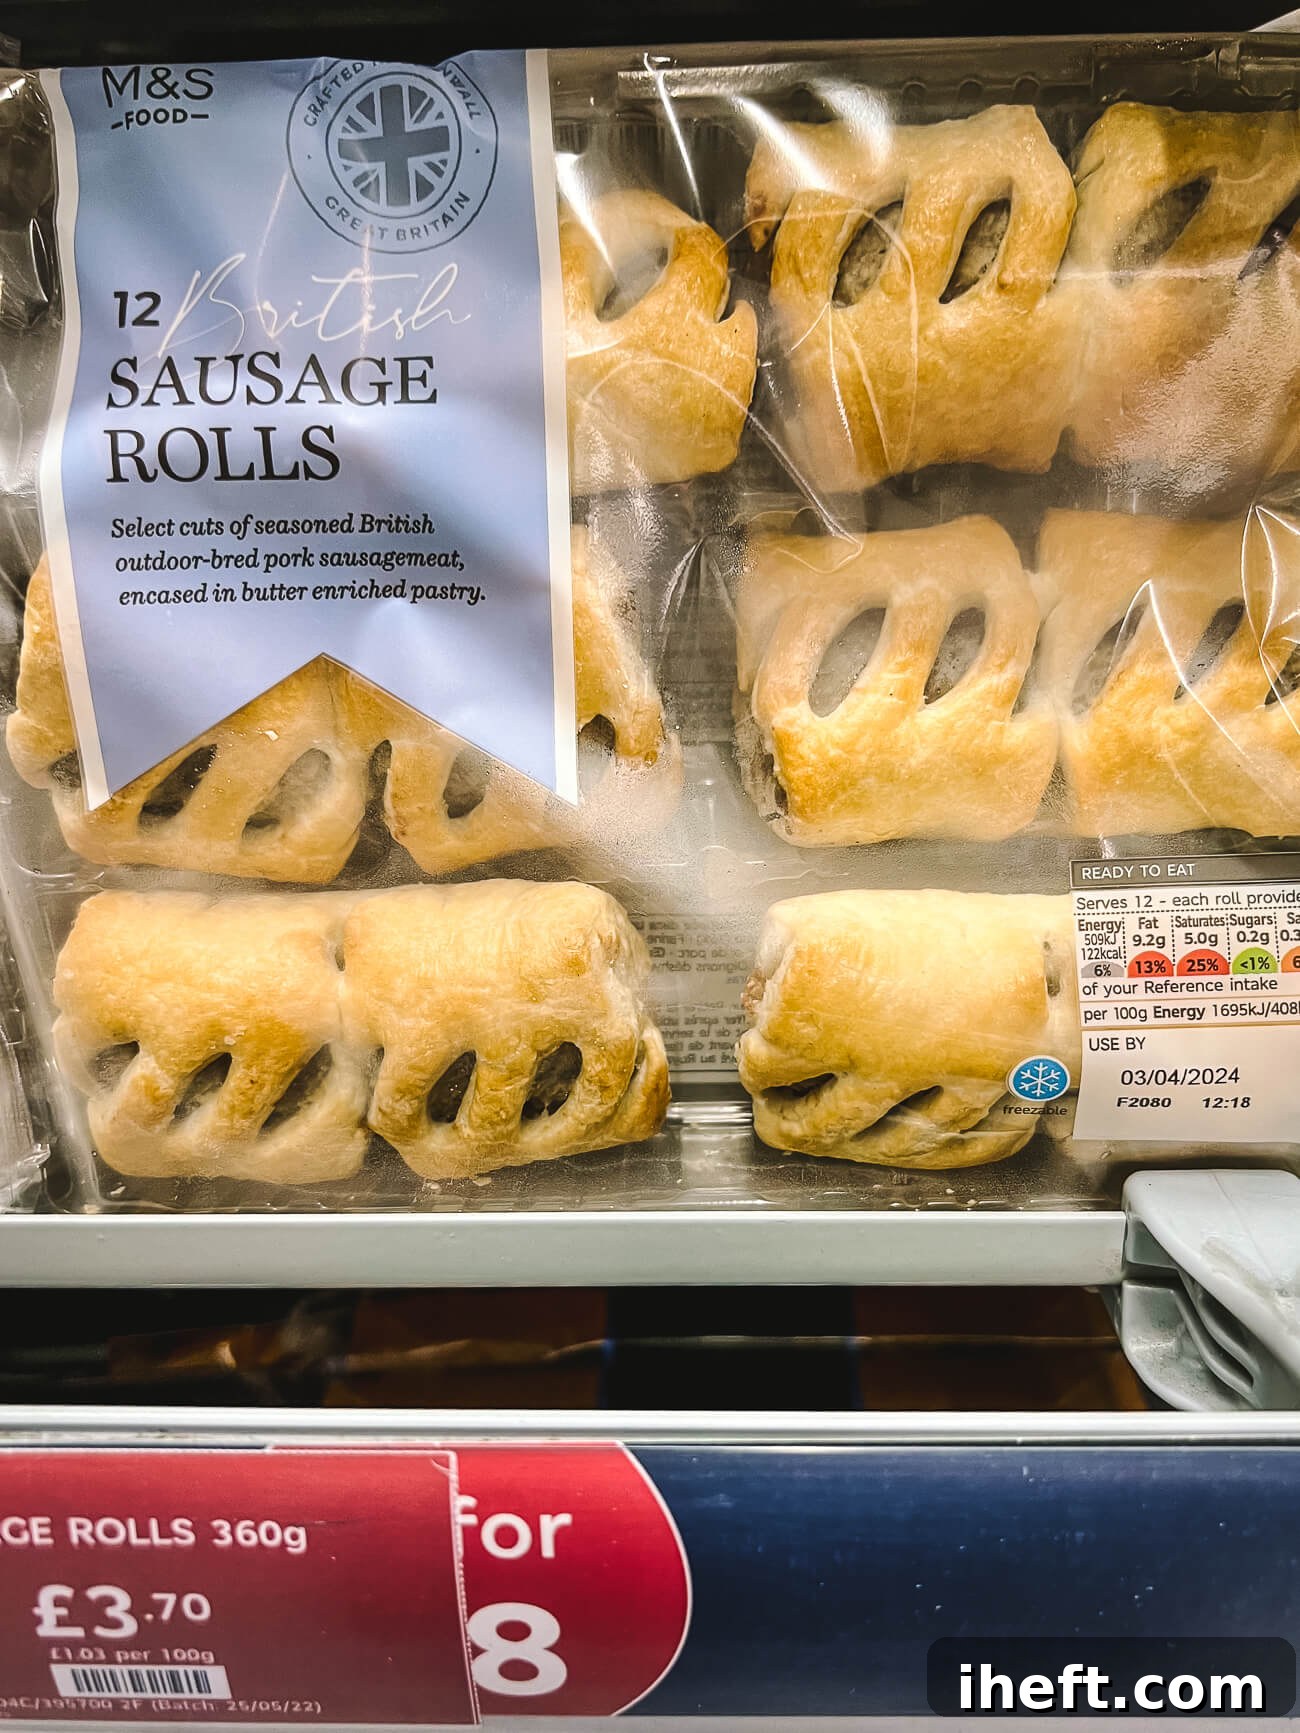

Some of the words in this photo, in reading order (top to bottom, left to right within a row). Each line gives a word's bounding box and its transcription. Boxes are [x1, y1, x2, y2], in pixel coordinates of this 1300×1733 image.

[102, 66, 215, 108] M&S
[303, 61, 365, 128] CRAFTED
[124, 107, 189, 130] FOOD
[396, 191, 472, 241] BRITAIN
[113, 290, 162, 329] 12
[157, 252, 472, 359] British
[105, 350, 438, 410] SAUSAGE
[104, 424, 341, 483] ROLLS
[111, 516, 175, 538] Select
[179, 517, 225, 536] cuts
[229, 514, 254, 541] of
[254, 513, 355, 535] seasoned
[358, 513, 436, 534] British
[115, 548, 260, 572] outdoor-bred
[263, 547, 315, 573] pork
[319, 549, 465, 572] sausagemeat,
[119, 582, 209, 605] encased
[212, 583, 237, 603] in
[242, 581, 308, 601] butter
[311, 578, 408, 600] enriched
[410, 582, 486, 606] pastry.
[1081, 865, 1134, 880] READY
[1139, 864, 1161, 877] TO
[1167, 863, 1195, 876] EAT
[1076, 896, 1128, 910] Serves
[1135, 895, 1153, 908] 12
[1172, 892, 1209, 906] each
[1215, 891, 1242, 905] roll
[1078, 918, 1122, 934] Energy
[1138, 916, 1159, 930] Fat
[1174, 914, 1225, 928] Saturates
[1229, 913, 1274, 928] Sugars
[1084, 932, 1117, 946] 509kJ
[1132, 933, 1166, 949] 9.2g
[1184, 931, 1218, 947] 5.0g
[1236, 930, 1270, 945] 0.2g
[1081, 946, 1122, 960] 122kcal
[1094, 963, 1112, 977] 6%
[1136, 960, 1167, 974] 13%
[1186, 958, 1219, 973] 25%
[1240, 956, 1270, 970] <1%
[1082, 981, 1098, 996] of
[1103, 983, 1138, 998] your
[1144, 979, 1224, 994] Reference
[1230, 976, 1278, 991] intake
[1083, 1009, 1108, 1024] per
[1114, 1006, 1148, 1022] 100g
[1153, 1005, 1206, 1020] Energy
[1212, 1001, 1300, 1018] 1695kJ/408
[1088, 1037, 1120, 1051] USE
[1125, 1036, 1146, 1051] BY
[1120, 1066, 1241, 1087] 03/04/2024
[1002, 1104, 1068, 1116] freezable
[1116, 1097, 1172, 1108] F2080
[1202, 1096, 1251, 1109] 12:18
[0, 1516, 54, 1547] GE
[67, 1516, 197, 1547] ROLLS
[210, 1518, 308, 1555] 360g
[456, 1495, 573, 1560] for
[32, 1583, 212, 1639] £3.70
[115, 1648, 151, 1664] per
[161, 1647, 215, 1664] 100g
[467, 1601, 568, 1696] 8
